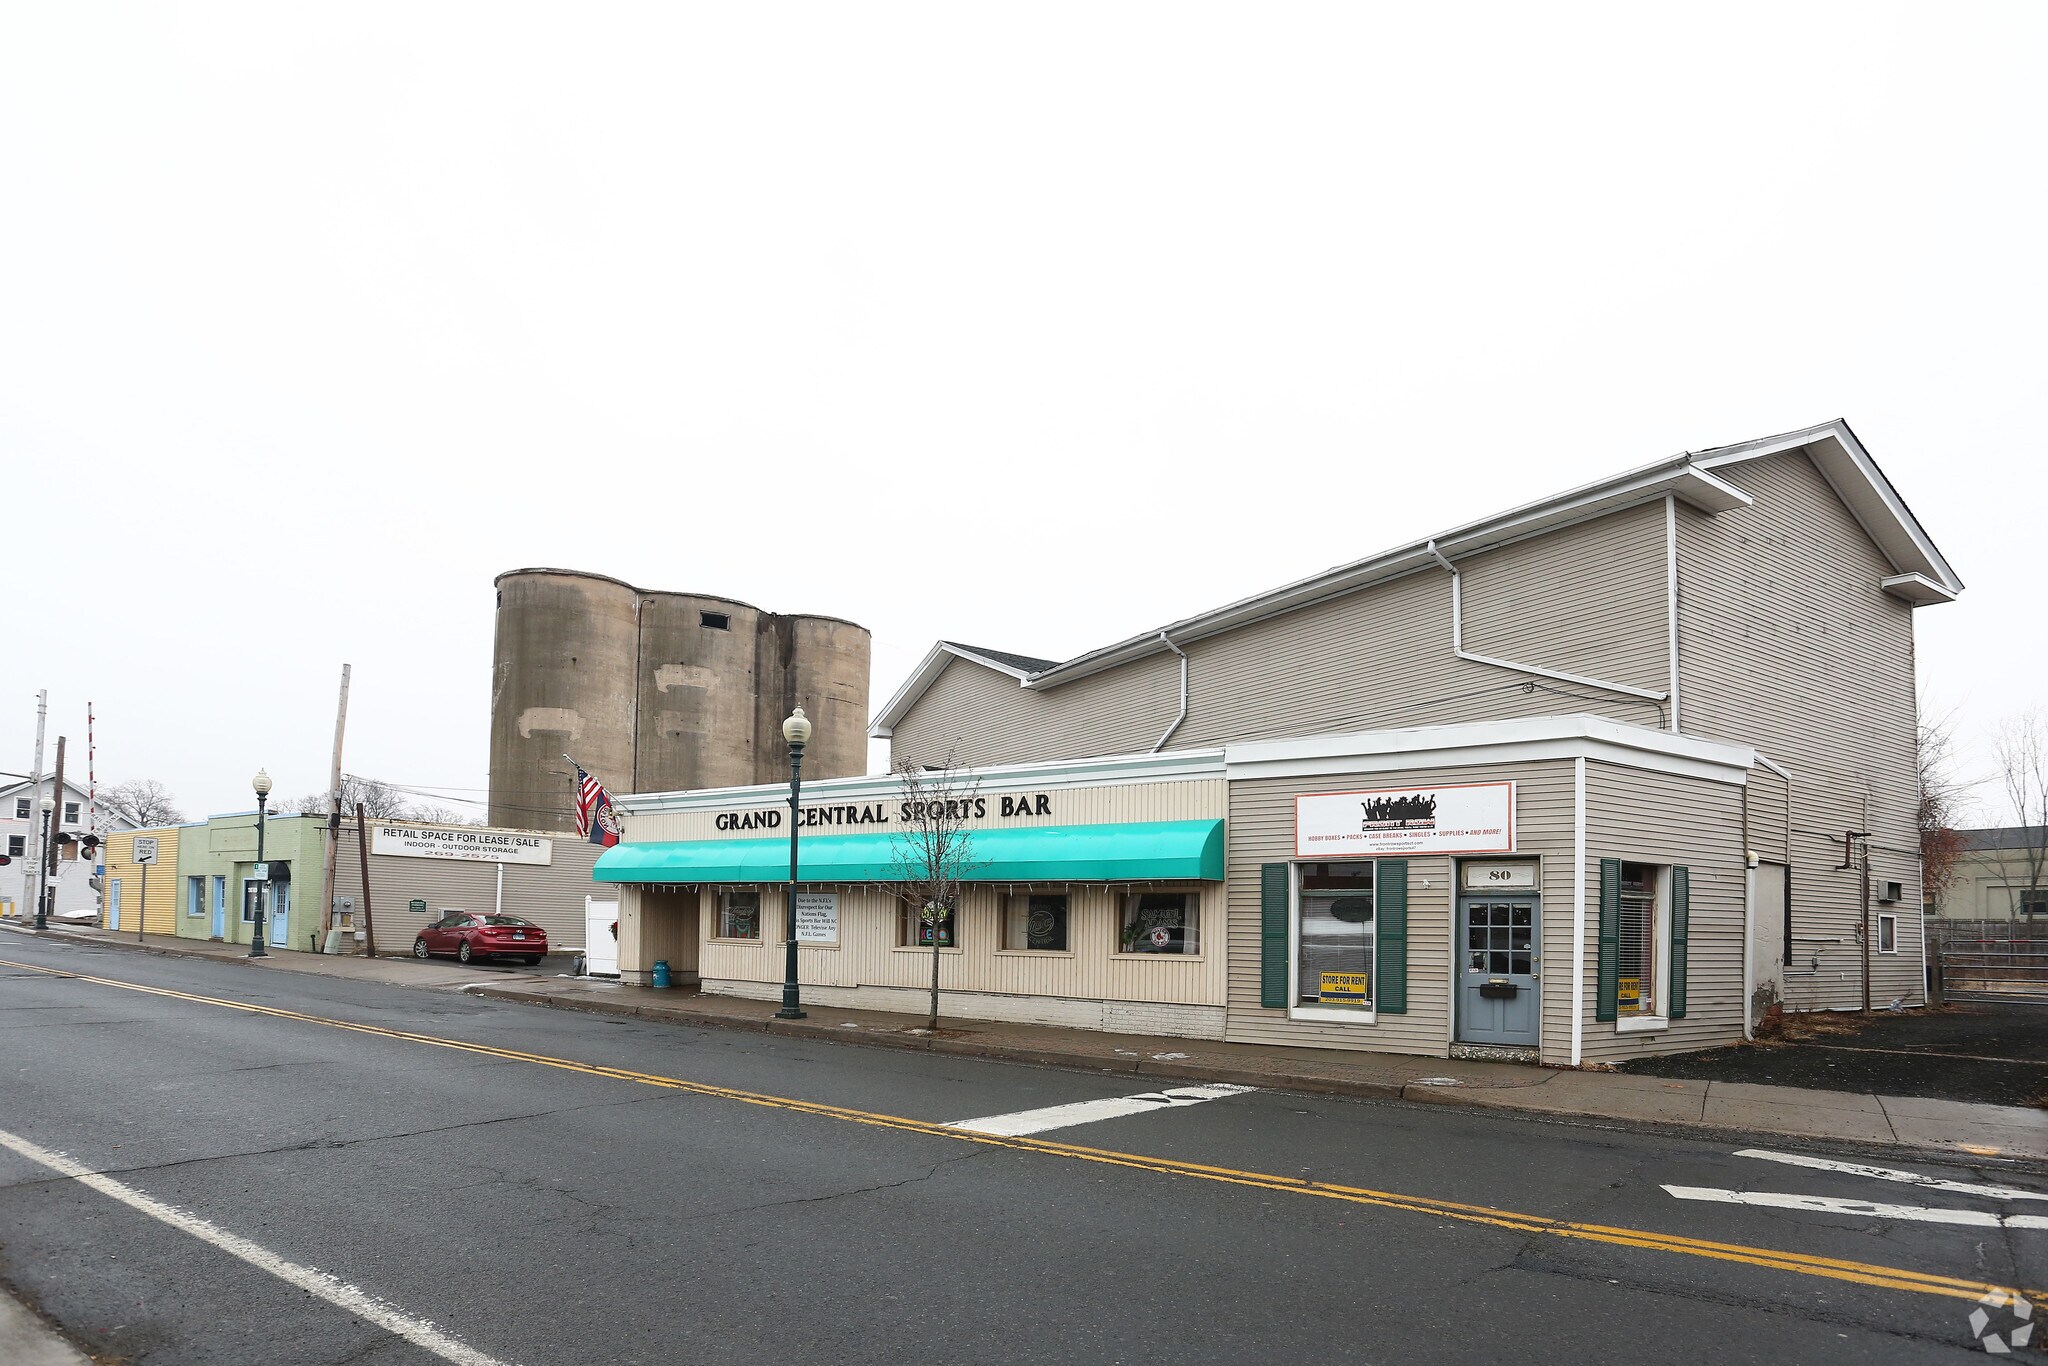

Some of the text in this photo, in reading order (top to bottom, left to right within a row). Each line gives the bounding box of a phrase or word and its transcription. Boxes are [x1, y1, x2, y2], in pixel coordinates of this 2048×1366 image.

[715, 794, 1051, 831] GRAND CENTRAL SPORTS BAR
[383, 828, 418, 839] RETAIL
[421, 831, 454, 842] SPACE
[457, 833, 476, 843] FOR
[1438, 829, 1465, 837] SUPPLIES
[404, 841, 436, 849] INDOOR
[442, 843, 481, 852] OUTDOOR
[482, 846, 519, 854] STORAGE
[1489, 870, 1511, 880] 80
[921, 929, 948, 940] KEO
[1322, 975, 1365, 985] STORE FOR RENT
